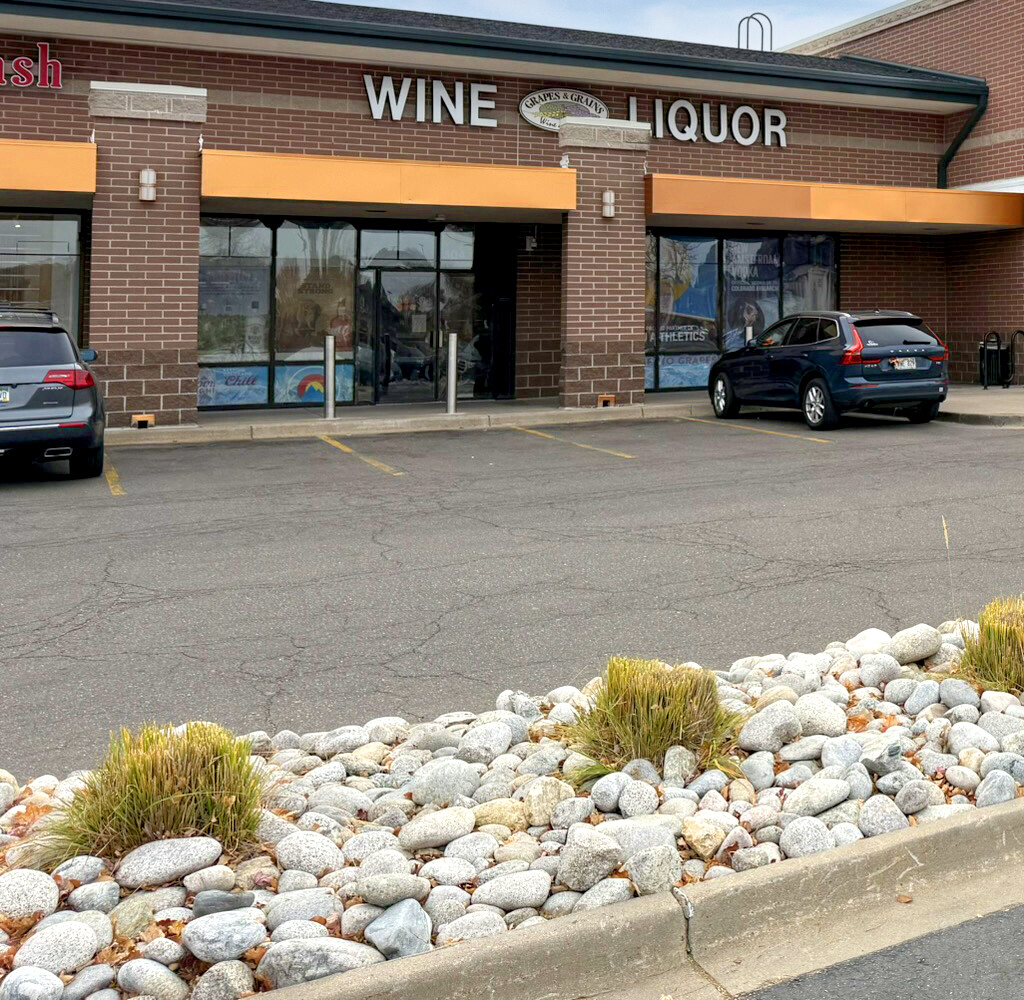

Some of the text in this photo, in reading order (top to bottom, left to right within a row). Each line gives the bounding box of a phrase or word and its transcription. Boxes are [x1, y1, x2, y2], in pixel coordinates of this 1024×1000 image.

[363, 74, 498, 128] WINE
[524, 91, 605, 114] GRAPES & GRAINS
[224, 375, 258, 386] Chill
